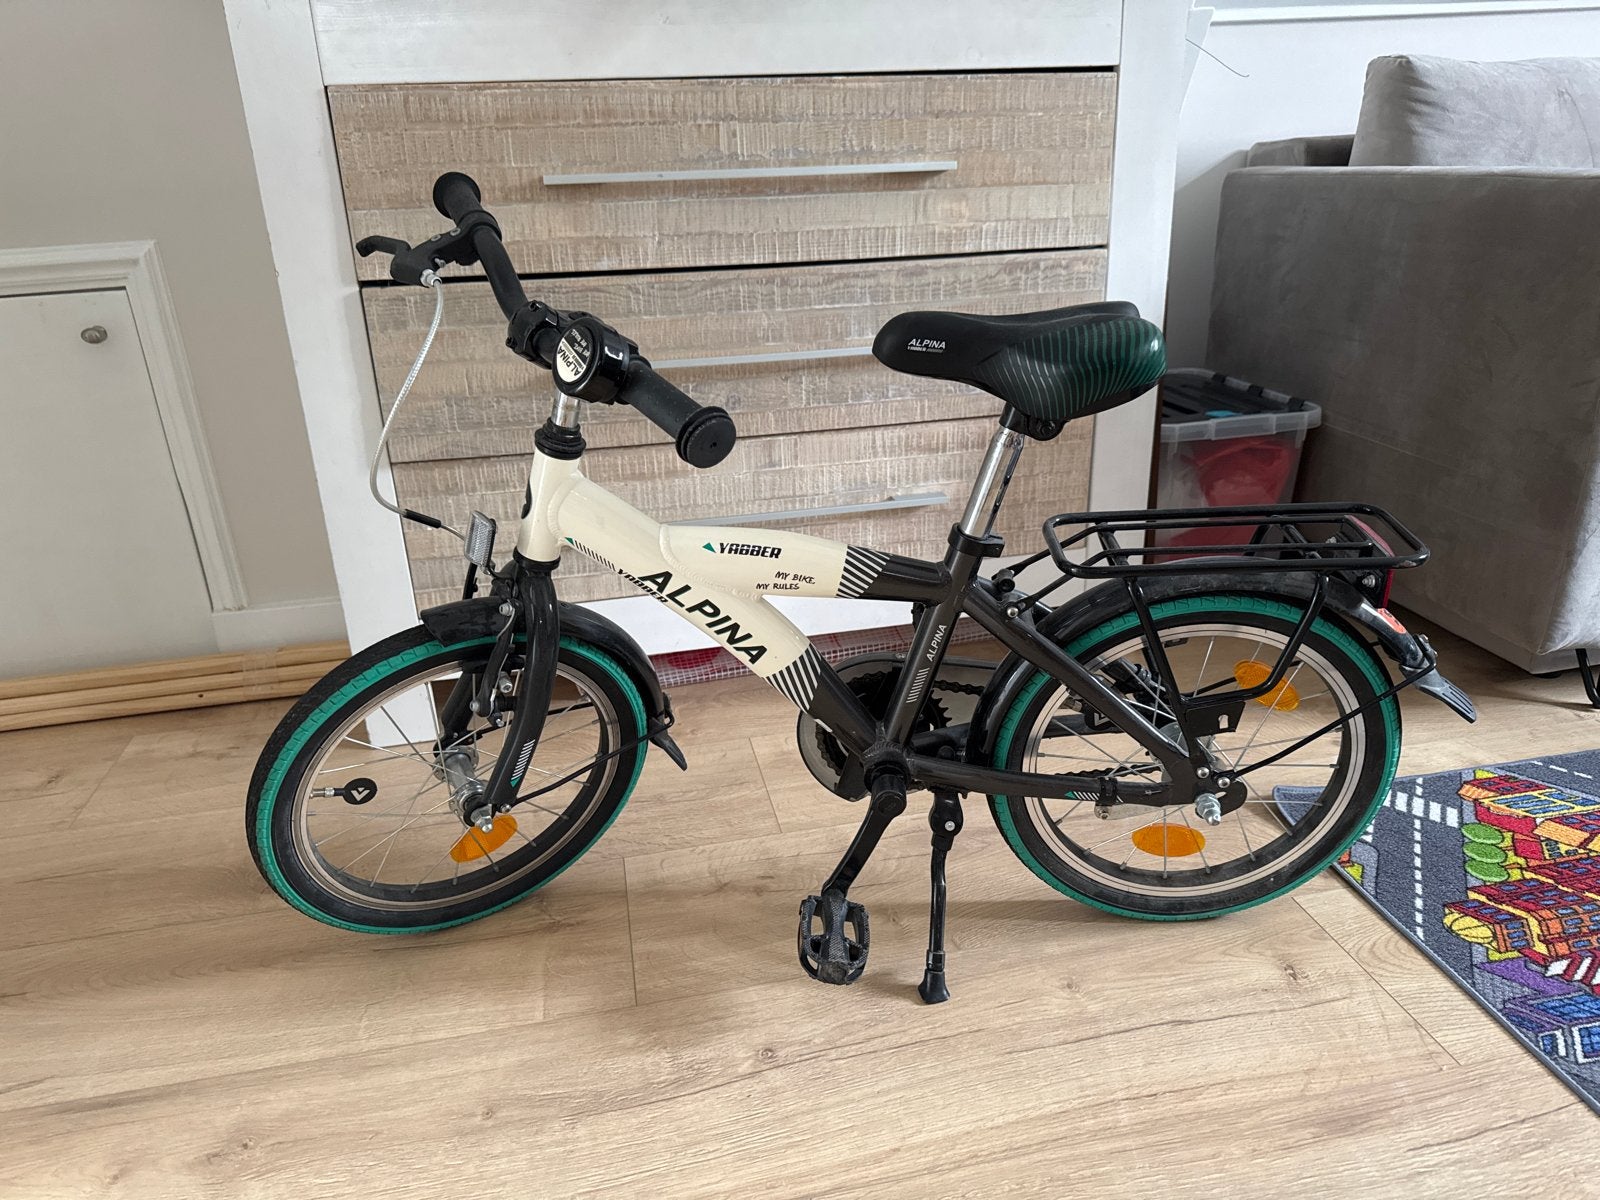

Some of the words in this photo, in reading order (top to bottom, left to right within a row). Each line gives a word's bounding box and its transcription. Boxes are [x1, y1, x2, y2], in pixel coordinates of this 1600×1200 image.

[908, 338, 946, 349] ALPINA
[557, 346, 581, 376] ALPINA
[719, 542, 782, 559] YABBER
[775, 571, 790, 581] MY
[755, 582, 770, 590] MY
[773, 582, 800, 590] RULES
[637, 570, 767, 665] ALPINA
[926, 624, 947, 662] ALPINA
